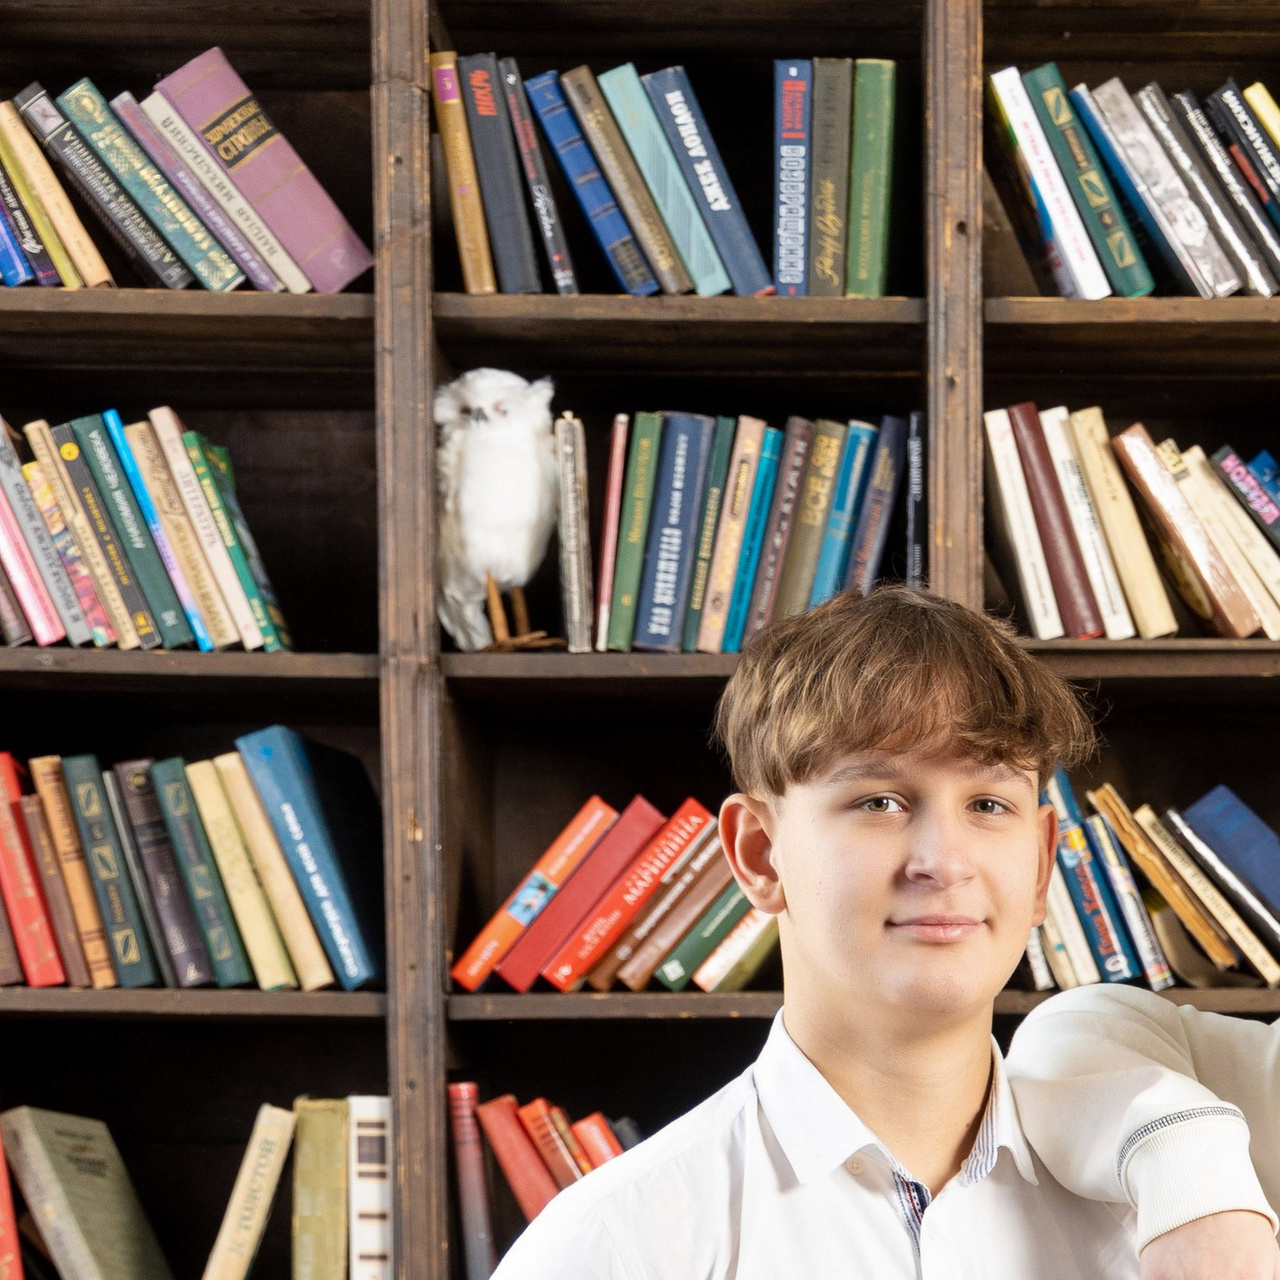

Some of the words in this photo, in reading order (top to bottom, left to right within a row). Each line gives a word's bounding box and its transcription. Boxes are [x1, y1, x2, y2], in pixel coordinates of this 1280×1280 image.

[661, 87, 709, 162] ЛОНДОН
[59, 128, 120, 197] МАРИНИНА
[691, 157, 732, 215] ДЖЕК
[112, 193, 177, 266] АЛЕКСАНДРА
[778, 144, 805, 283] ВОЗВРАЩЕНИЕ
[82, 428, 124, 491] ЧЕЛОВЕКА
[107, 486, 149, 552] АНАТОМИЯ
[617, 811, 706, 906] МАРИНИНА
[235, 1134, 277, 1235] ТОЛСТОЙ
